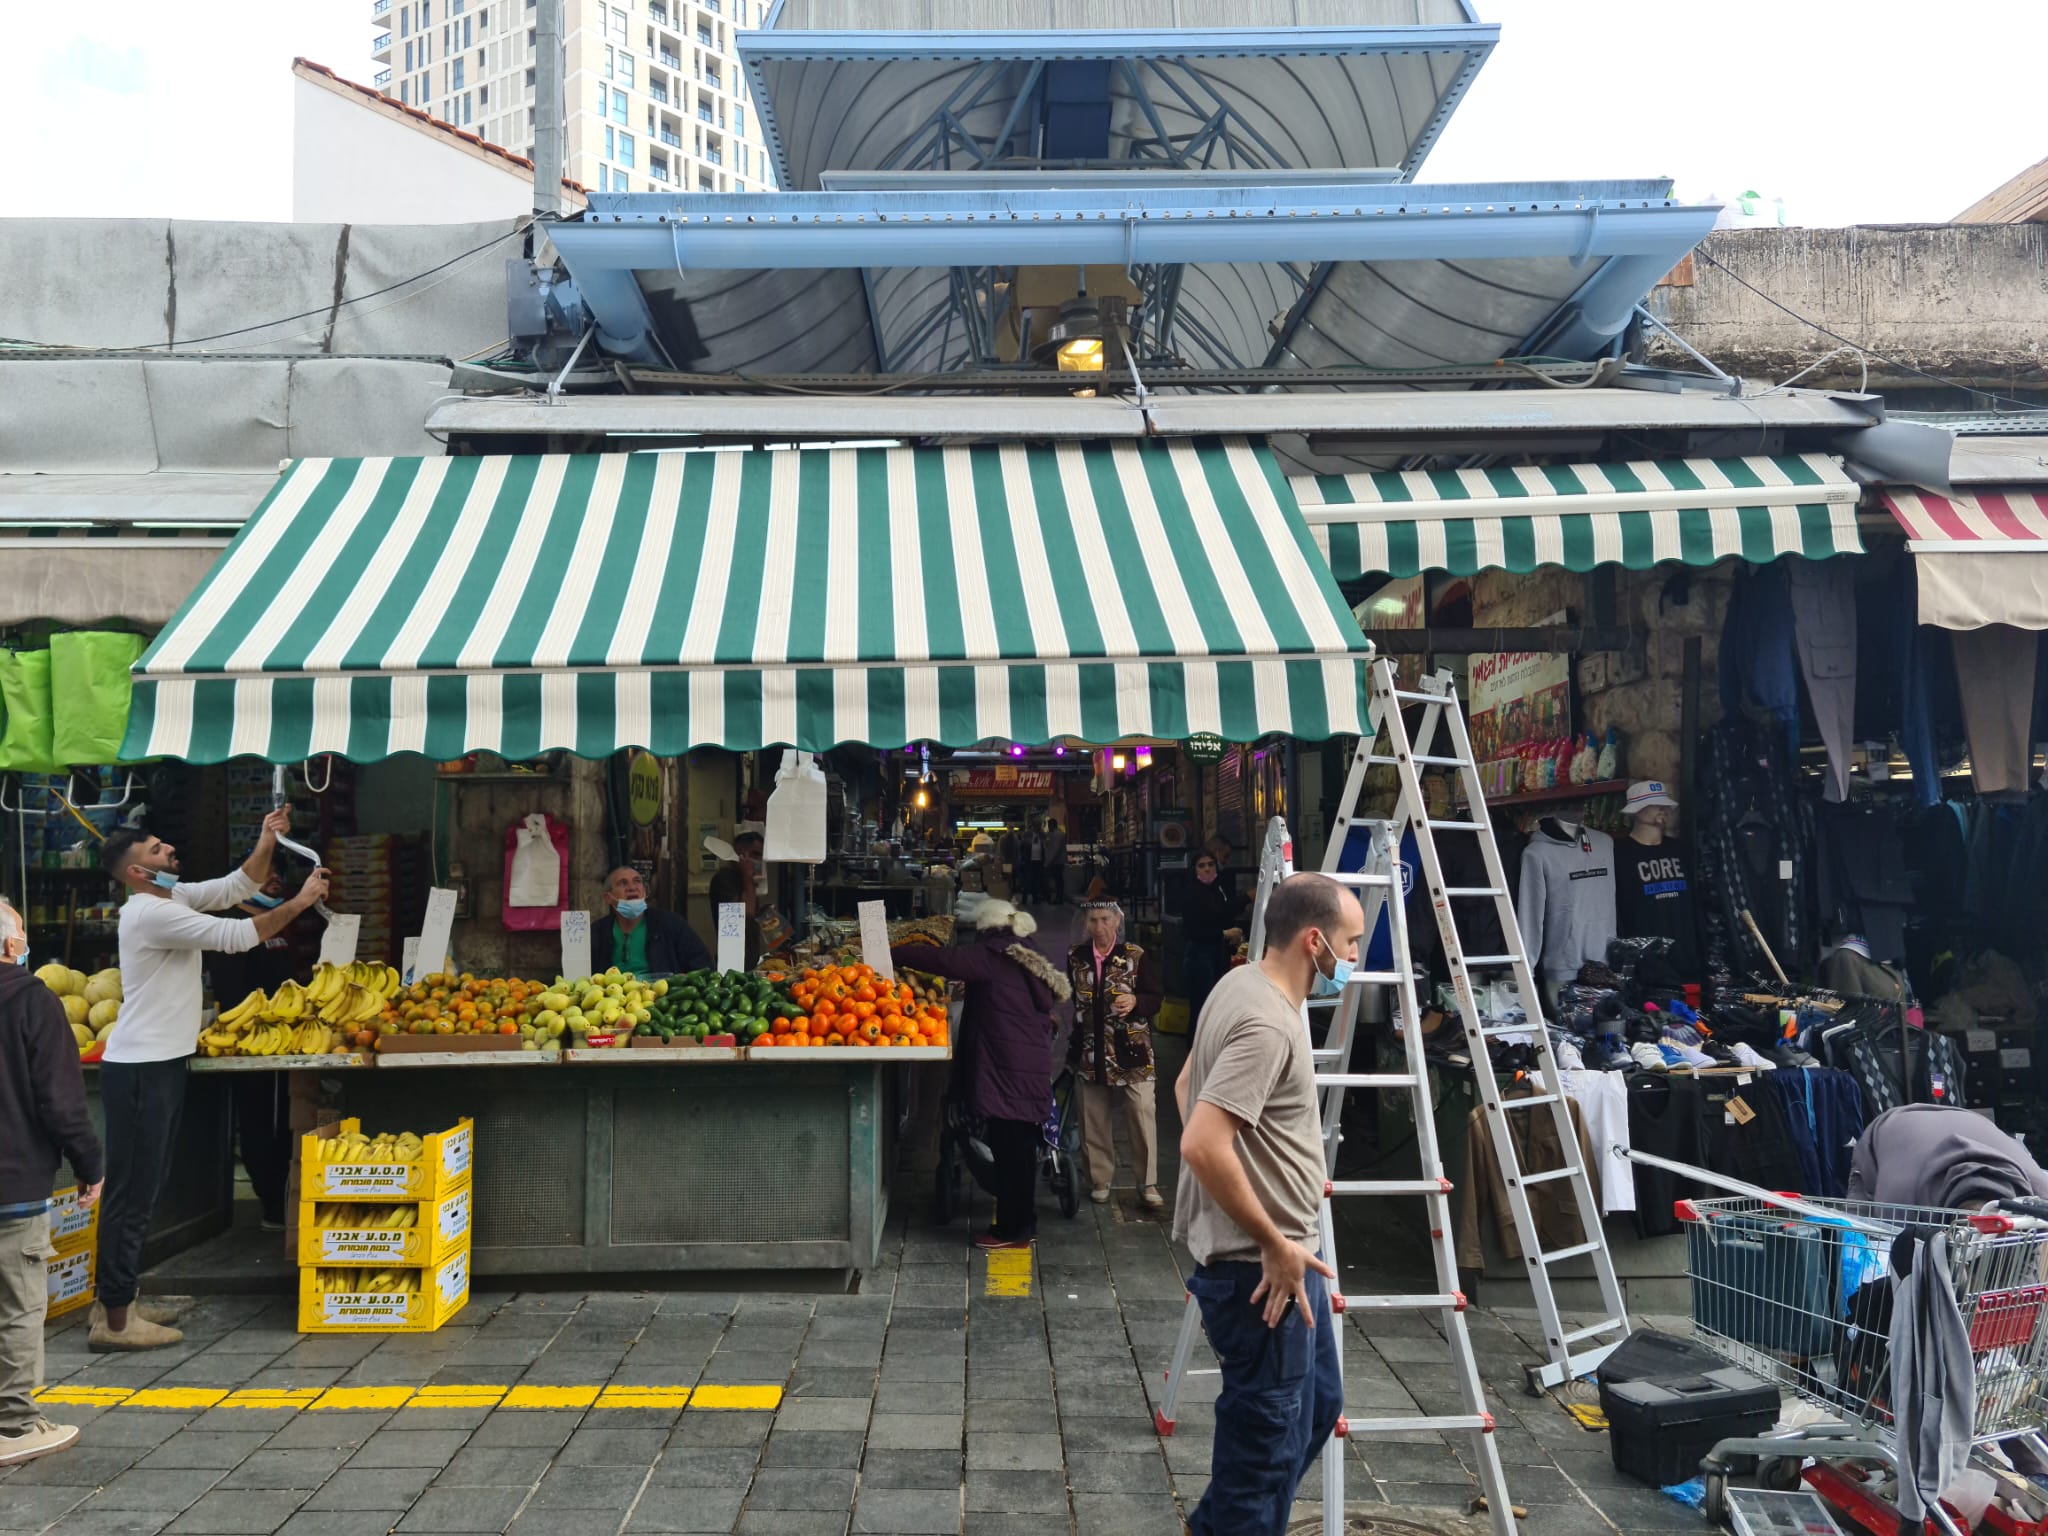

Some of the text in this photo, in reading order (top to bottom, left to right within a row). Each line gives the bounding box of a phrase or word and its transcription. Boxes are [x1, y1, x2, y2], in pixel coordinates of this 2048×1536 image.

[1189, 740, 1222, 752] אליהו
[1017, 771, 1053, 788] מעדנים
[1649, 783, 1662, 792] 09
[1637, 857, 1685, 882] CORE
